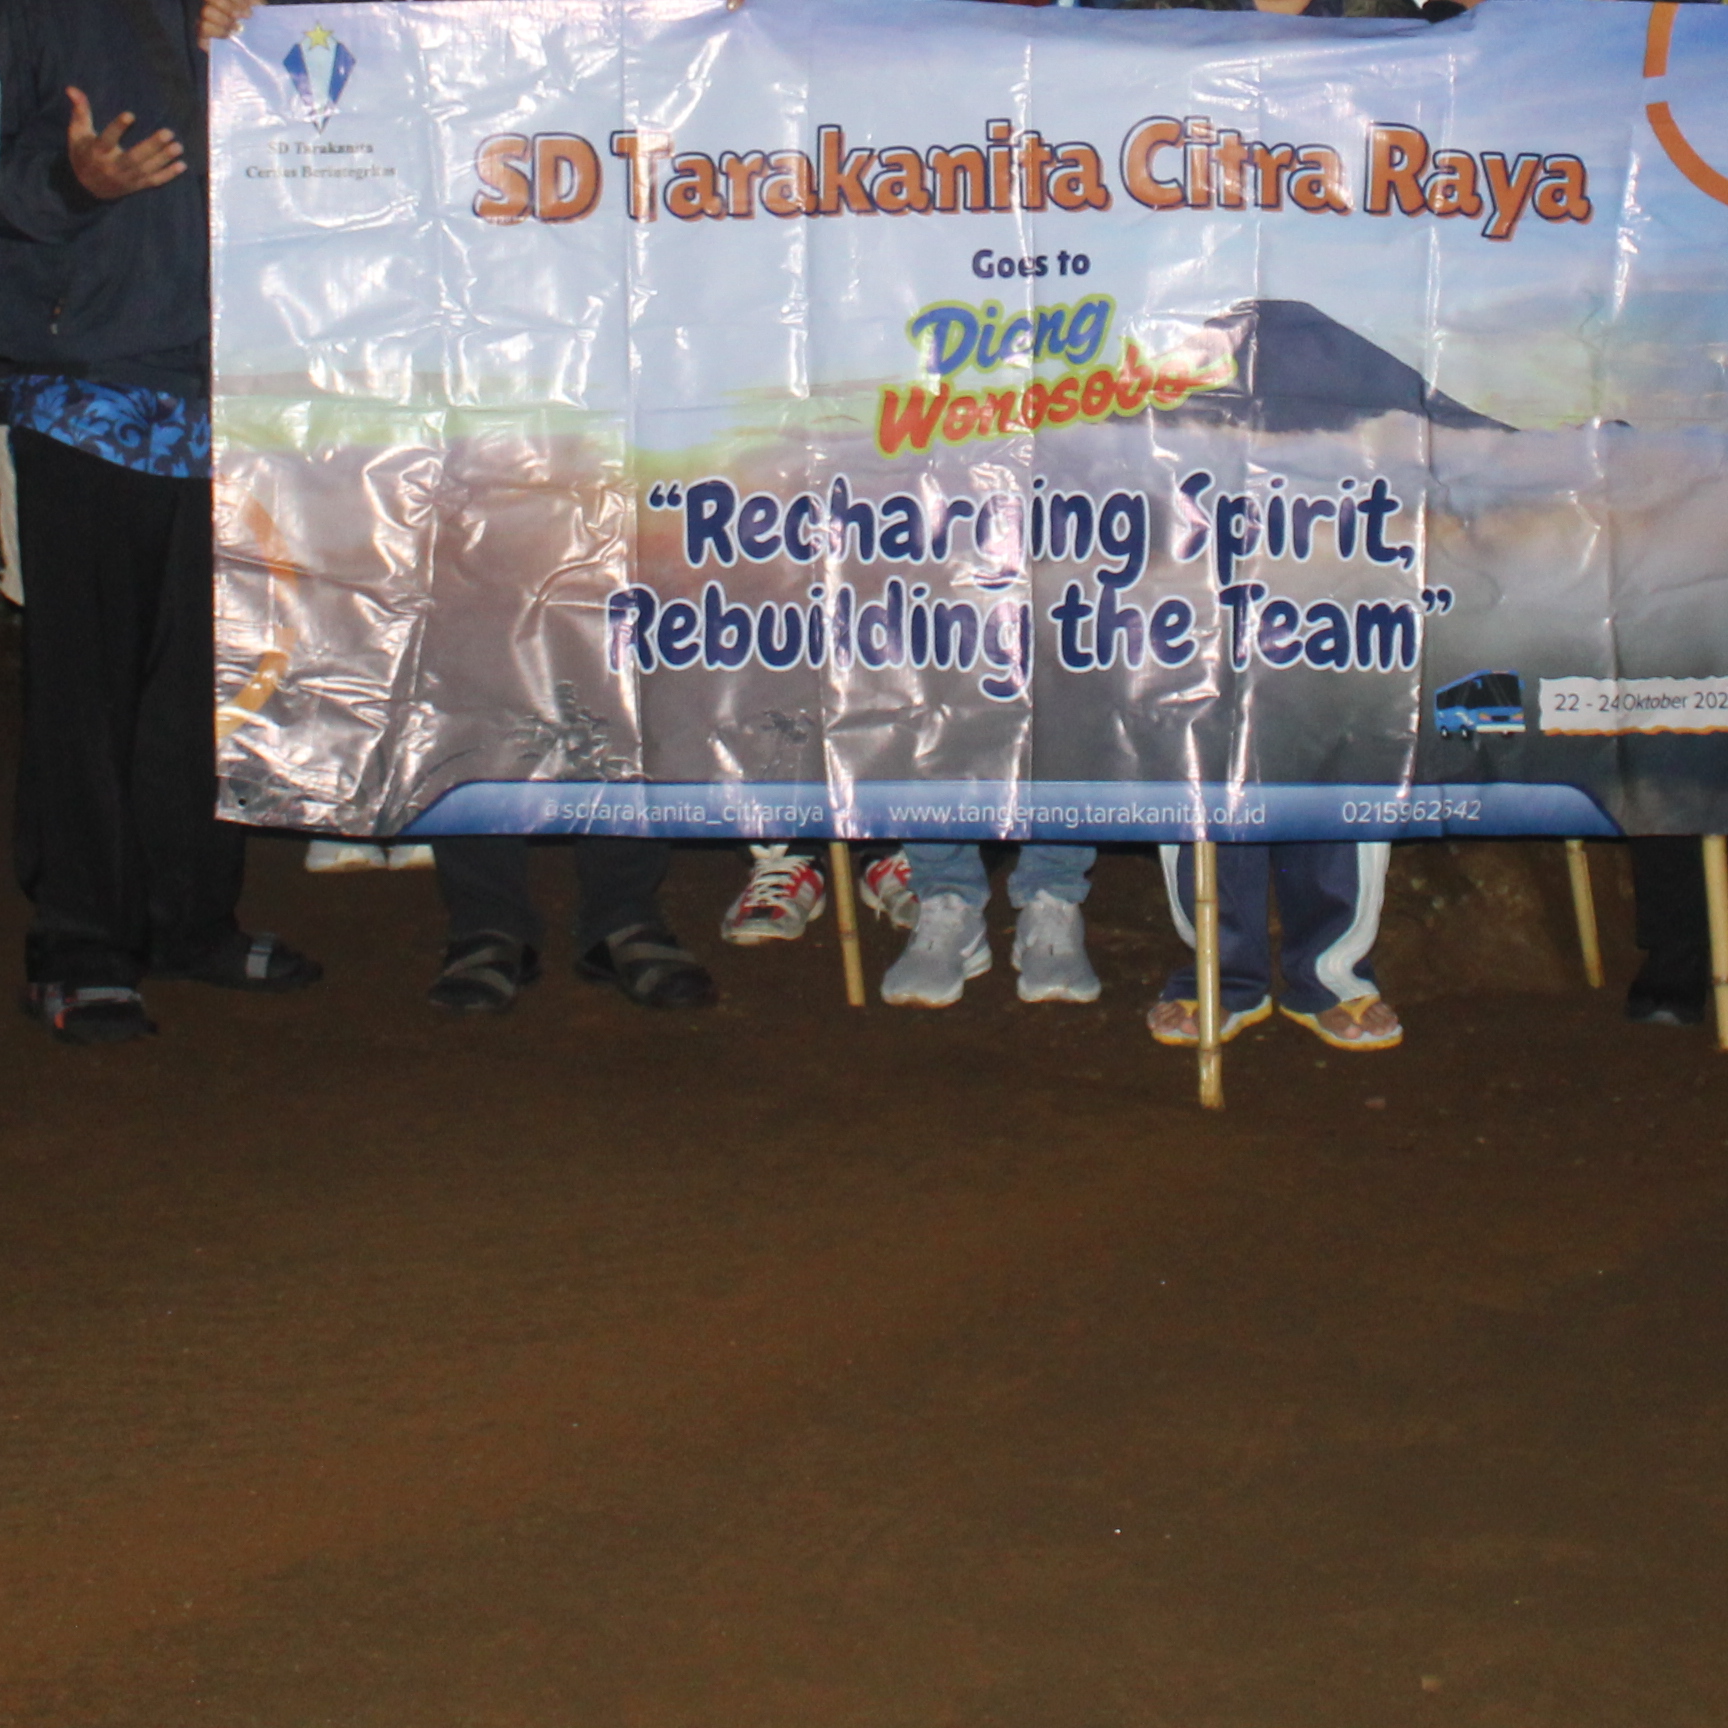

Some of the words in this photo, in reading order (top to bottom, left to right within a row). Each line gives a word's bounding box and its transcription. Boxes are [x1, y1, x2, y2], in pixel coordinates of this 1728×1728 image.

[472, 130, 604, 223] SD
[610, 118, 1114, 222] Tarakanita
[1119, 115, 1354, 213] Citra
[1363, 122, 1594, 243] Raya
[971, 248, 1049, 279] Goes
[1057, 248, 1092, 277] to
[876, 342, 1236, 456] Wonosobo
[1174, 471, 1416, 586] Spirit,
[607, 578, 1033, 701] Rebuilding
[1050, 582, 1197, 670] the
[1554, 693, 1580, 712] 22
[1598, 694, 1620, 712] 24
[1623, 692, 1689, 712] Oktober
